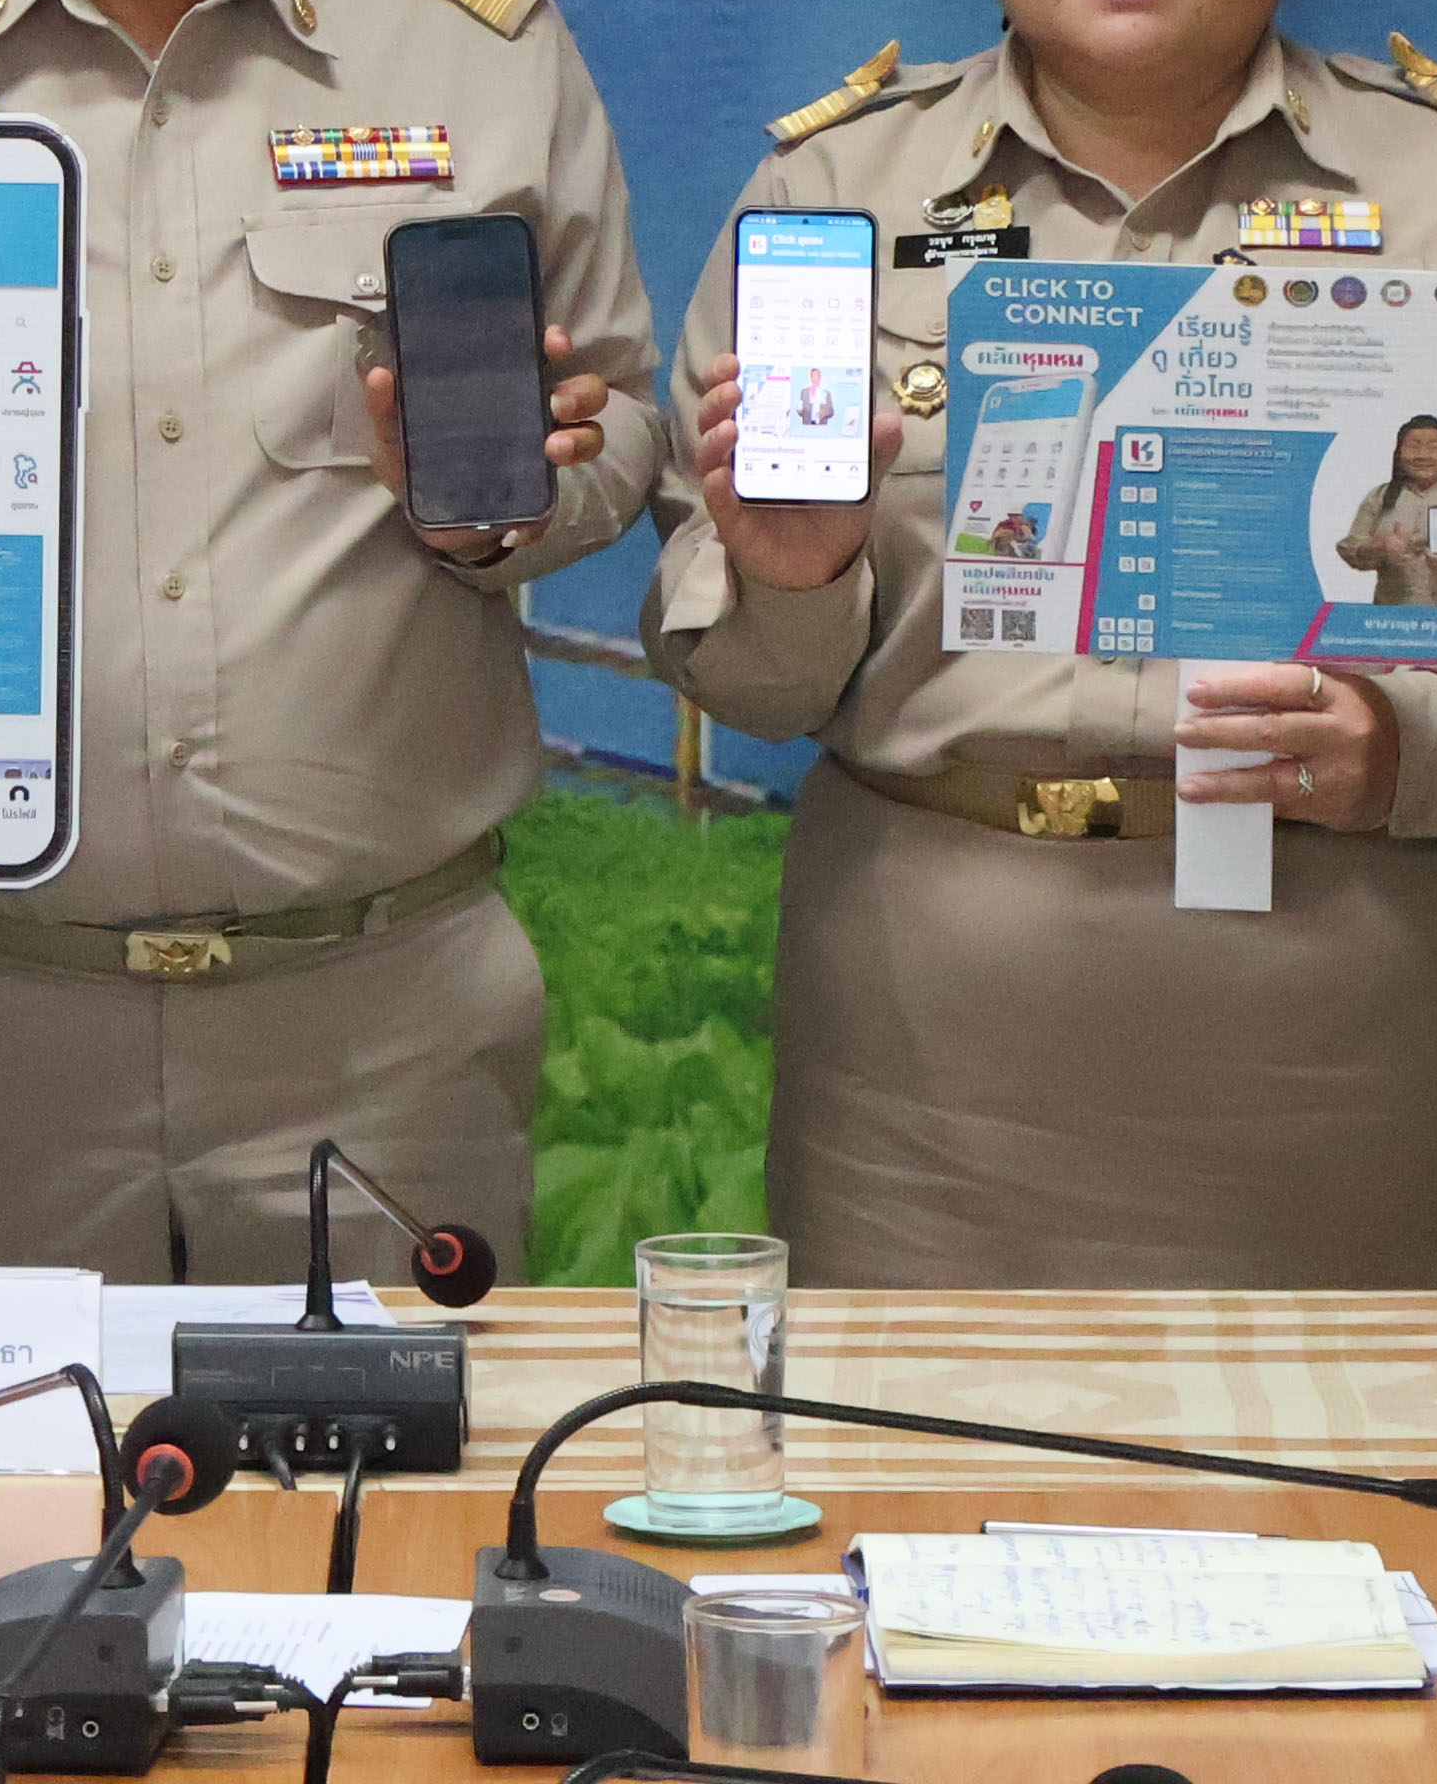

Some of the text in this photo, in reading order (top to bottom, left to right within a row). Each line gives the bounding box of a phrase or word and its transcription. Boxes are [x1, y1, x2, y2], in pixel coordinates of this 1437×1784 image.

[984, 276, 1114, 300] CLICK TO
[1005, 303, 1144, 327] CONNECT
[1177, 315, 1252, 346] เรียนรู้
[977, 347, 1084, 371] คลิกชุมชน
[1152, 349, 1167, 373] ดู
[1179, 339, 1238, 368] เที่ยว
[1175, 372, 1253, 399] ทั่วไทย
[389, 1349, 456, 1369] NPE
